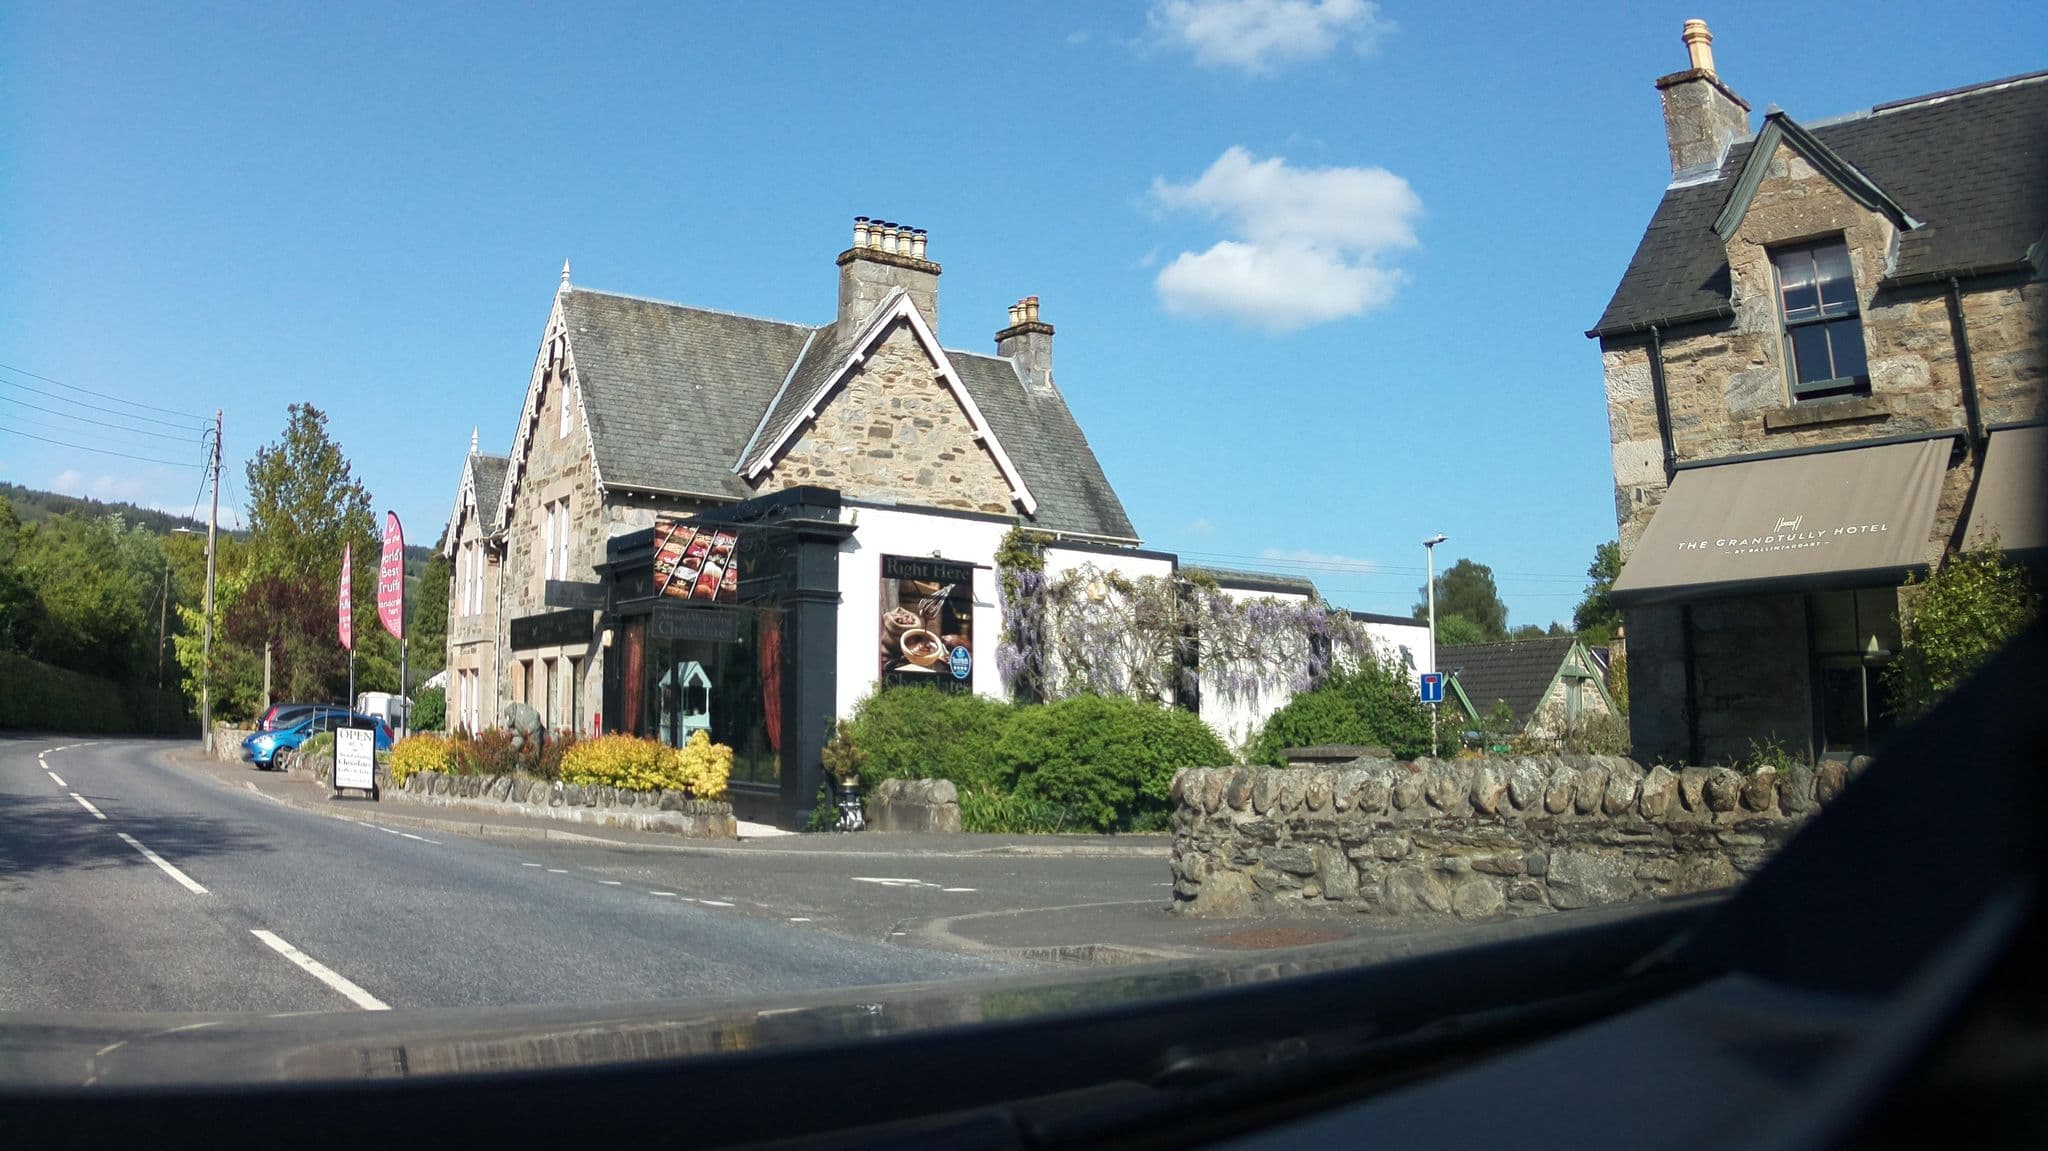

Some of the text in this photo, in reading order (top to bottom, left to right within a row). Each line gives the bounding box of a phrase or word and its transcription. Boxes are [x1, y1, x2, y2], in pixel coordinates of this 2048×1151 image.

[1678, 523, 1888, 550] THE GRANDTULLY HOTEL
[886, 557, 969, 580] Right Here
[659, 619, 730, 639] Chocolates
[340, 730, 372, 741] OPEN
